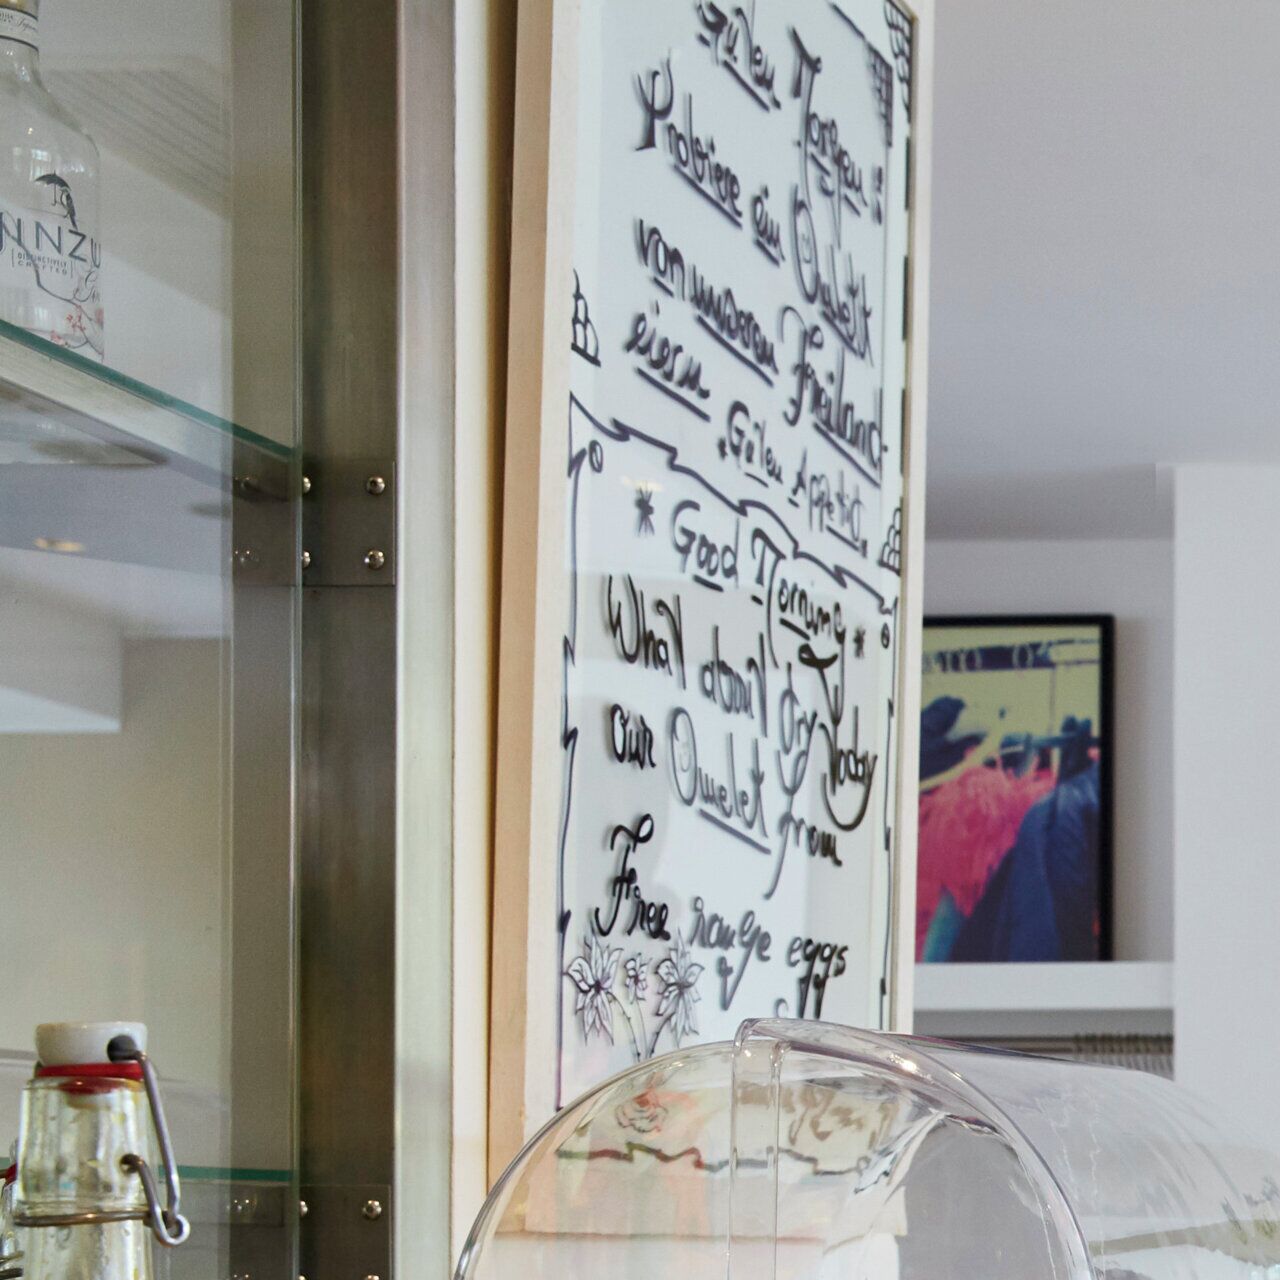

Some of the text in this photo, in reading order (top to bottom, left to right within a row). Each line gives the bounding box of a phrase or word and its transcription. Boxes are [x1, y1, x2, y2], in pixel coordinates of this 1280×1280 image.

[672, 500, 740, 590] Good
[609, 575, 686, 690] What
[670, 706, 769, 840] Omelet
[595, 813, 671, 941] Free
[690, 896, 771, 1010] range
